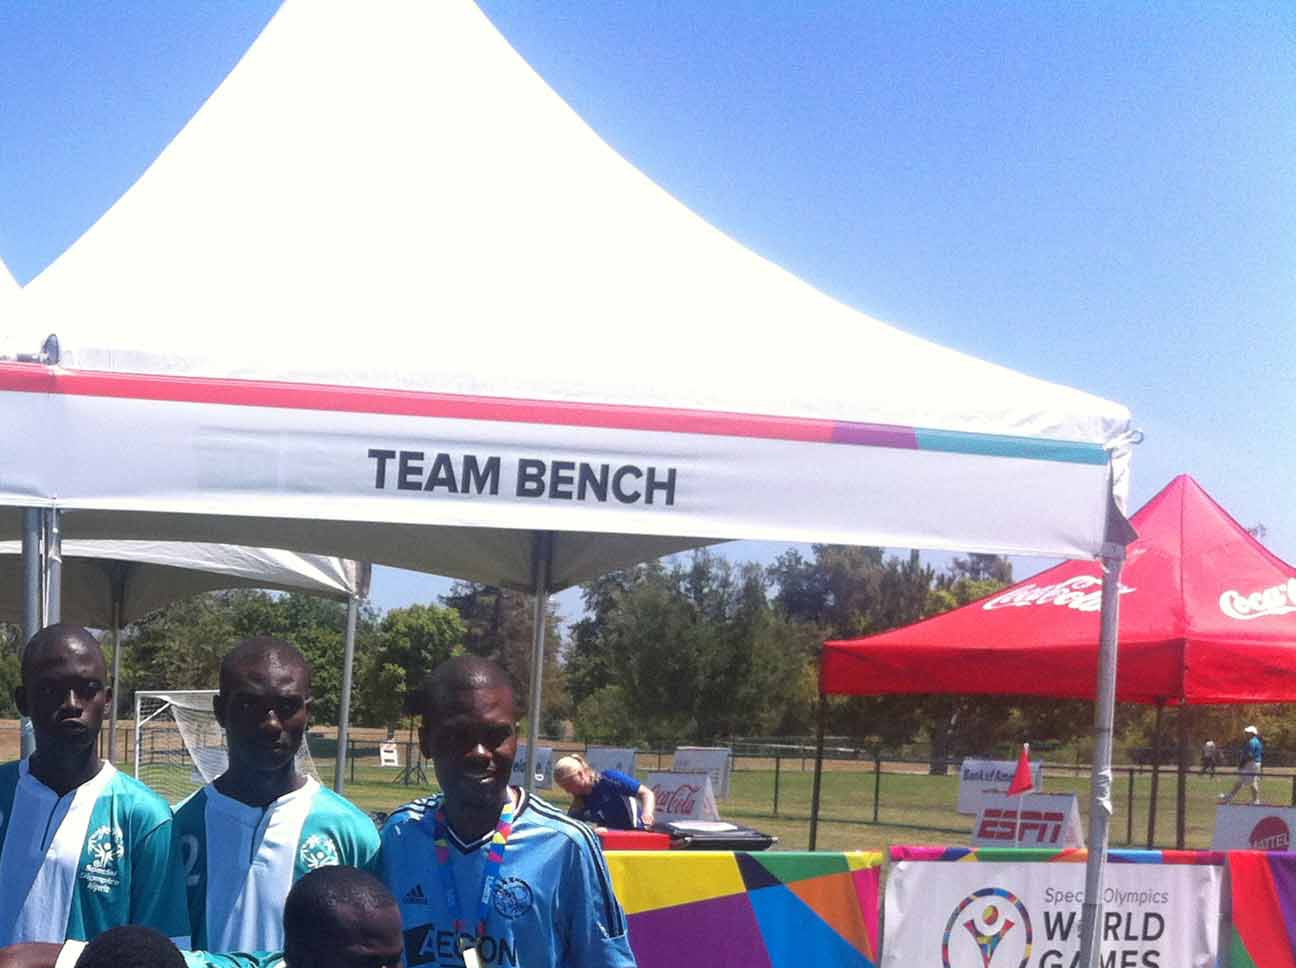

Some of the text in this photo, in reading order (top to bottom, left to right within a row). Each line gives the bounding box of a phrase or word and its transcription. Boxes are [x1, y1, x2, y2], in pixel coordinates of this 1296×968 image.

[368, 449, 676, 505] TEAM BENCH
[977, 808, 1064, 844] ESPN
[1044, 887, 1169, 906] Spec Olympics
[1043, 911, 1165, 942] WRLD
